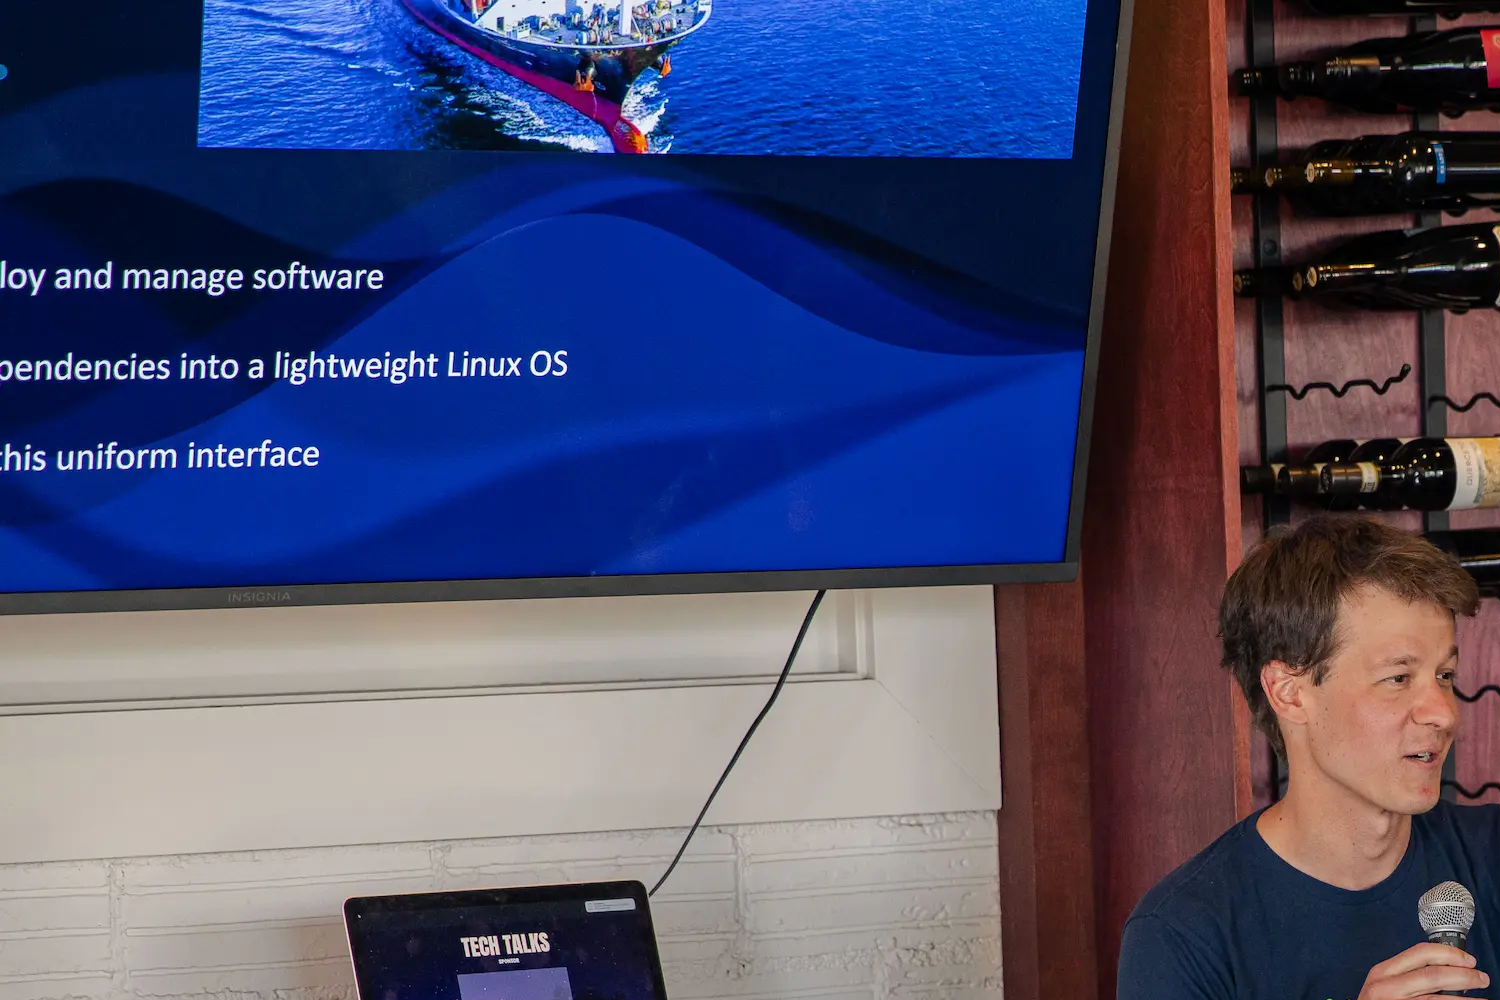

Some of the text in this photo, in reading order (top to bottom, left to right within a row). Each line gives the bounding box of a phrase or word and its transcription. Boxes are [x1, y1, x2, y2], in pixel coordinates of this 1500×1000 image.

[0, 261, 385, 296] loy and manage software
[180, 353, 240, 380] into
[248, 358, 265, 379] a
[274, 350, 438, 385] lightweight
[447, 351, 522, 378] Linux
[529, 350, 569, 377] OS
[56, 442, 178, 471] uniform
[187, 439, 320, 468] interface
[228, 591, 291, 603] INSIGNIA
[460, 932, 551, 958] TECH TALKS
[498, 957, 520, 965] SPONSOR
